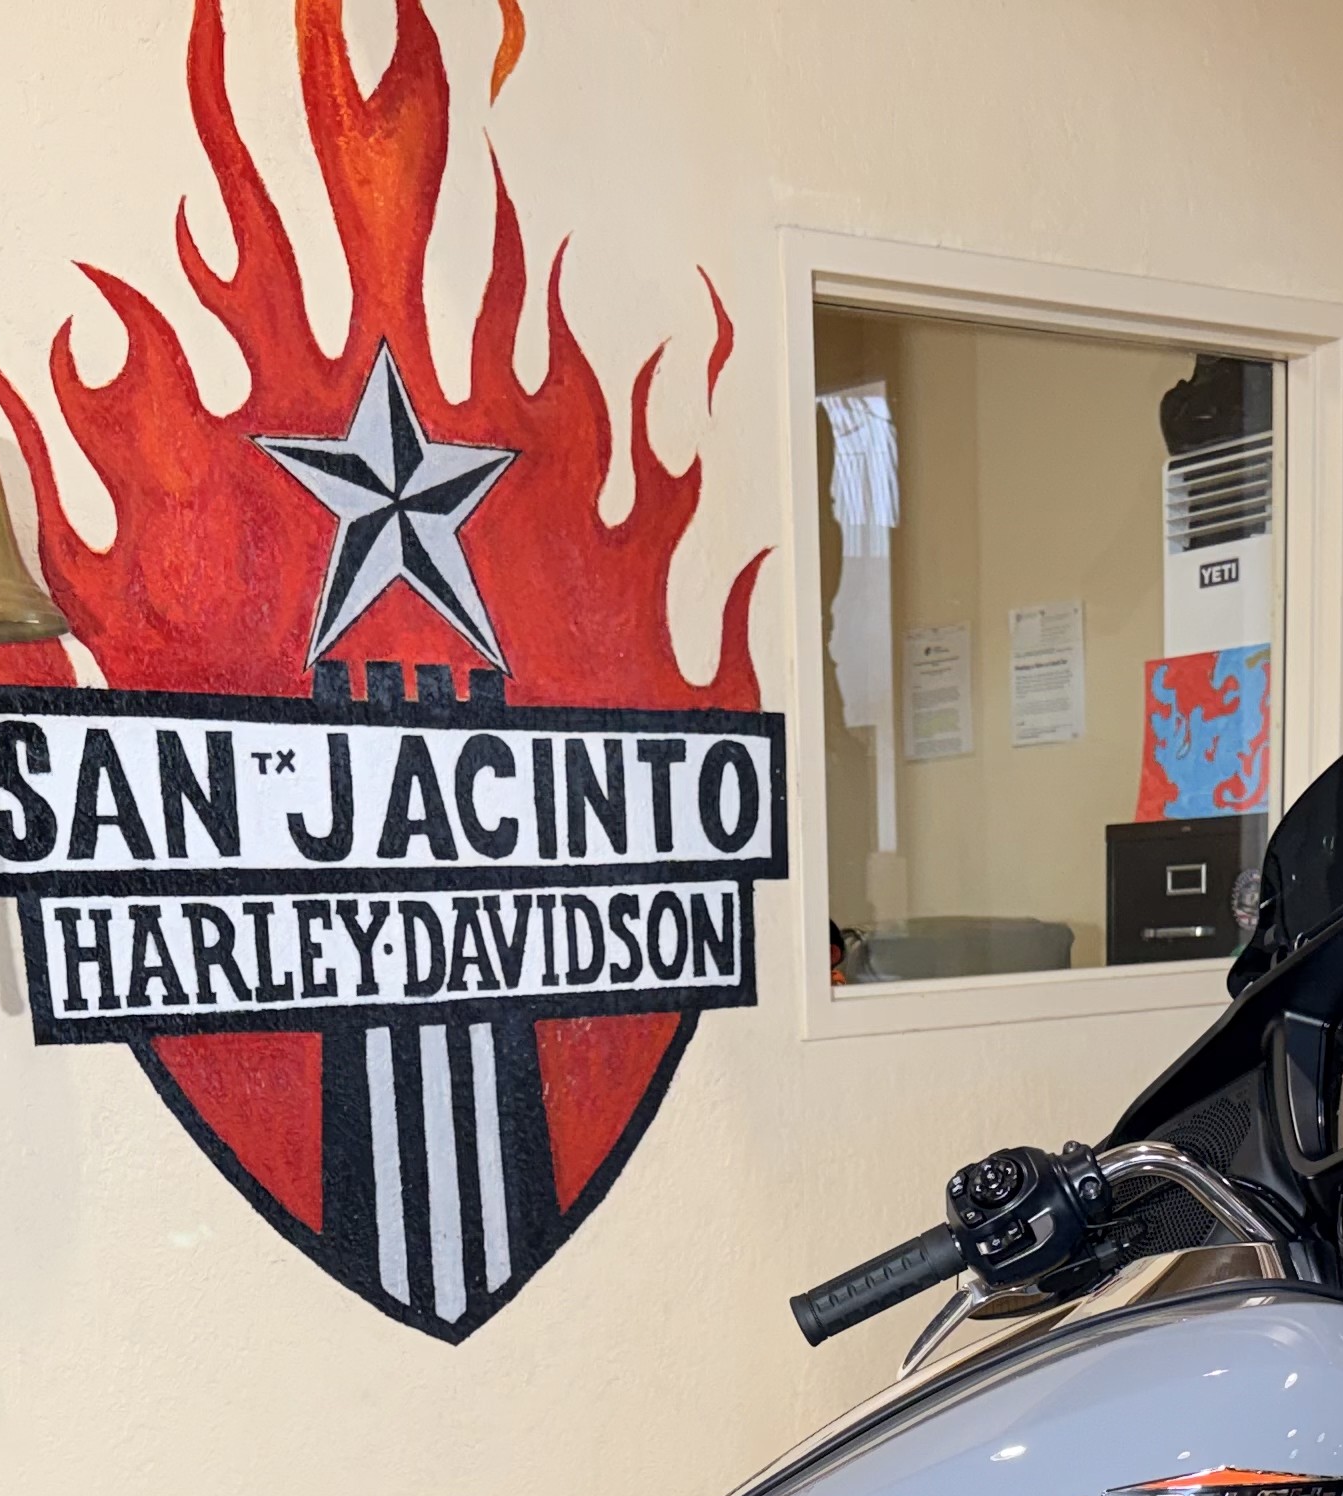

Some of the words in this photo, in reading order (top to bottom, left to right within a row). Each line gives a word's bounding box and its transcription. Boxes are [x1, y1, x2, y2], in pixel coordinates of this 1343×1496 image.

[1201, 562, 1237, 585] YETI
[251, 751, 297, 776] TX
[287, 731, 761, 864] JACINTO
